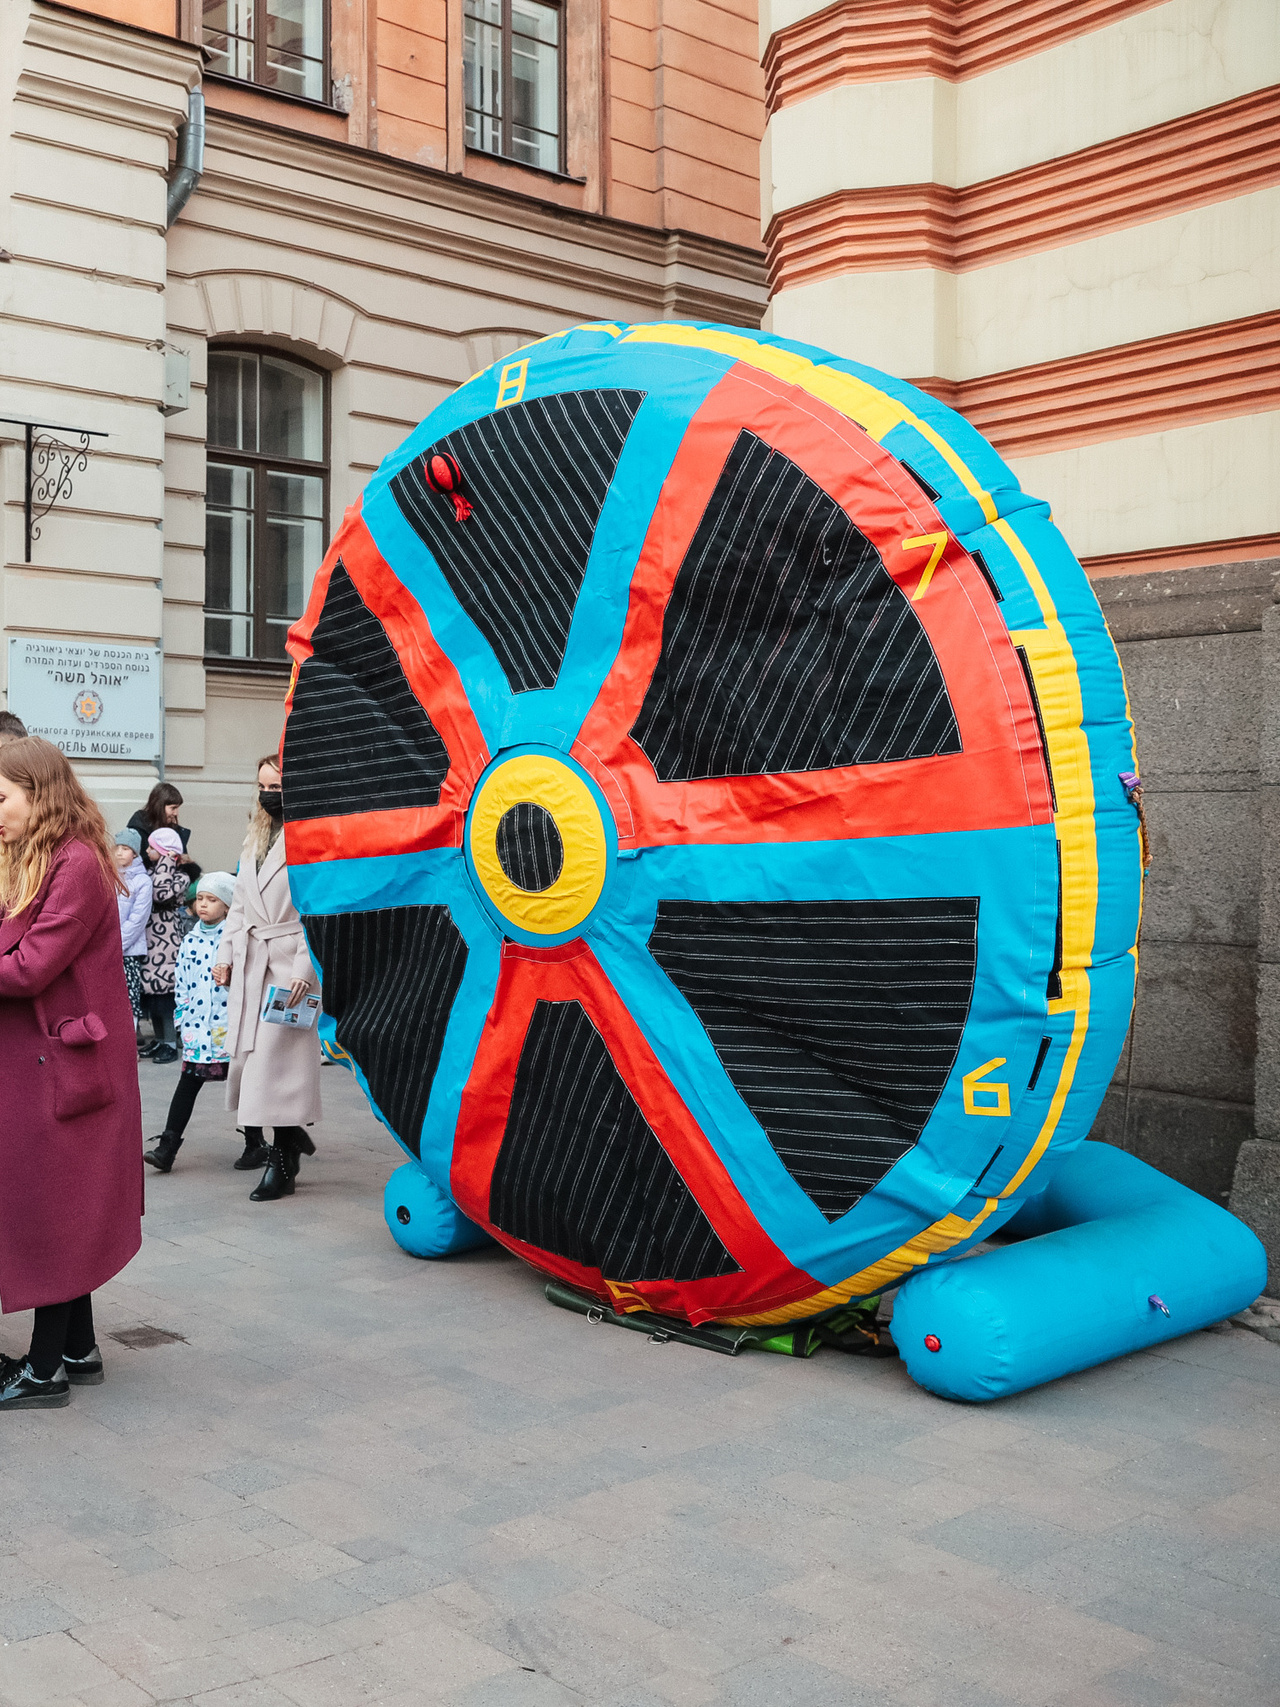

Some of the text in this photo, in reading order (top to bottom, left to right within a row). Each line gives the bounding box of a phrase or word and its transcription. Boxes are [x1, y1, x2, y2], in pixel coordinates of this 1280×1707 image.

[495, 358, 531, 410] 8
[902, 531, 948, 601] 7
[65, 647, 86, 656] יוצאי
[88, 647, 101, 657] של
[104, 650, 132, 659] הכנסת
[134, 652, 150, 661] בית
[24, 656, 150, 673] בנוסח הספרדים ועדות המזרח
[27, 725, 155, 741] Синагога грузинских евреев
[91, 742, 132, 755] МОШЕ»
[962, 1057, 1011, 1117] 6
[603, 1279, 655, 1313] 5
